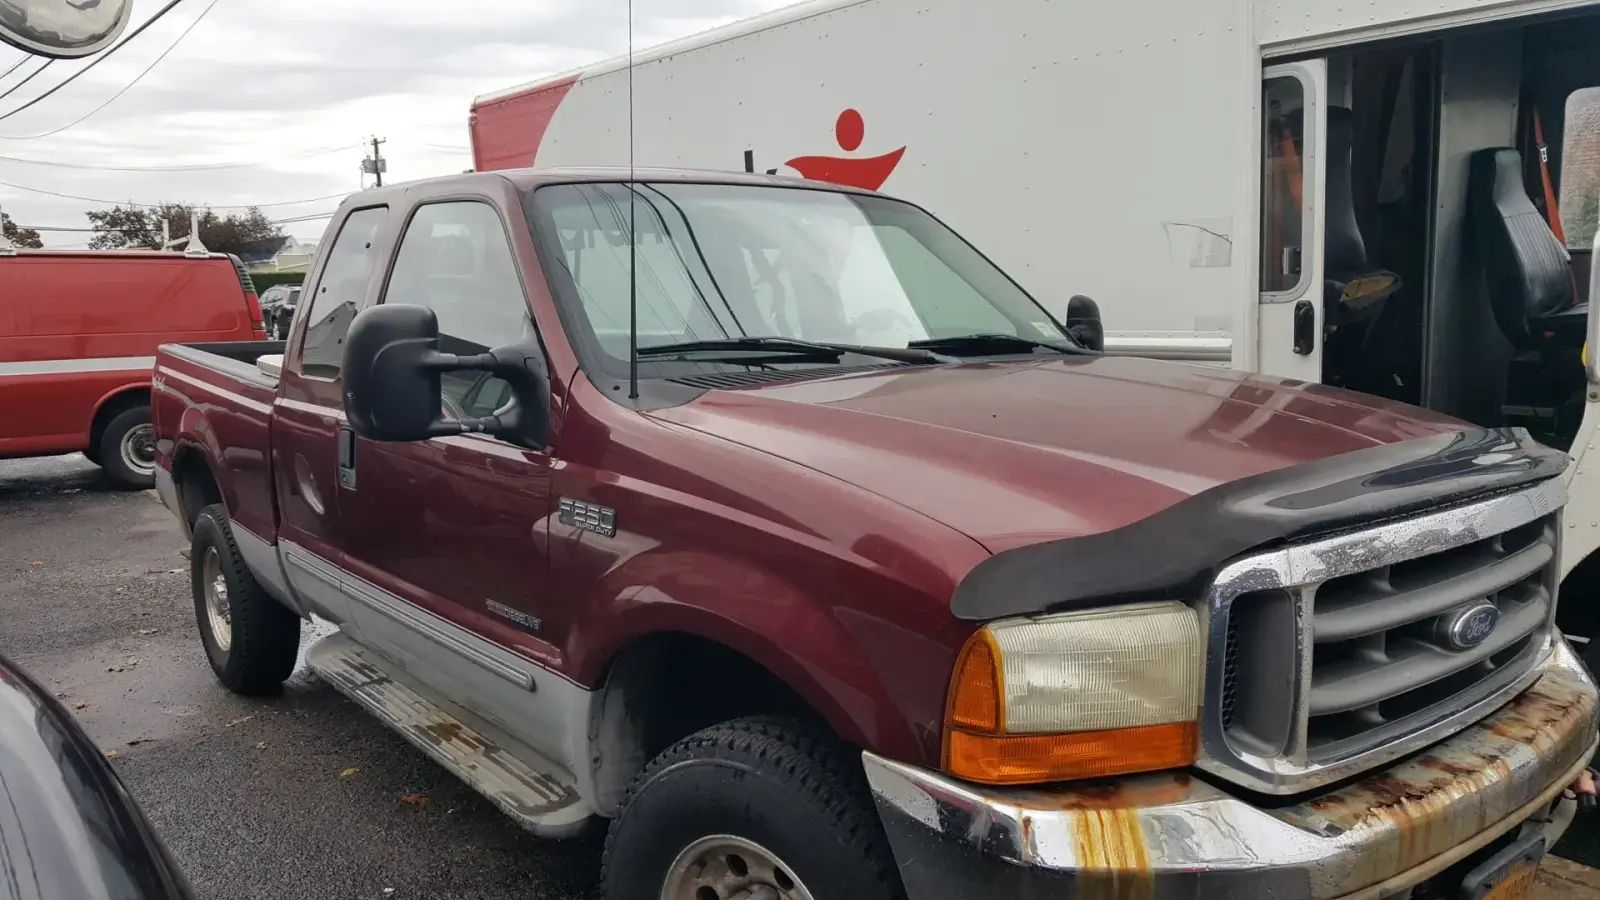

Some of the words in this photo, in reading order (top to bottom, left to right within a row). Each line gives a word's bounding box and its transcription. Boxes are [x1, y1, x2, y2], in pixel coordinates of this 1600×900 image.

[575, 521, 595, 531] SUPER
[595, 526, 613, 536] DUTY
[1467, 613, 1492, 640] Ford
